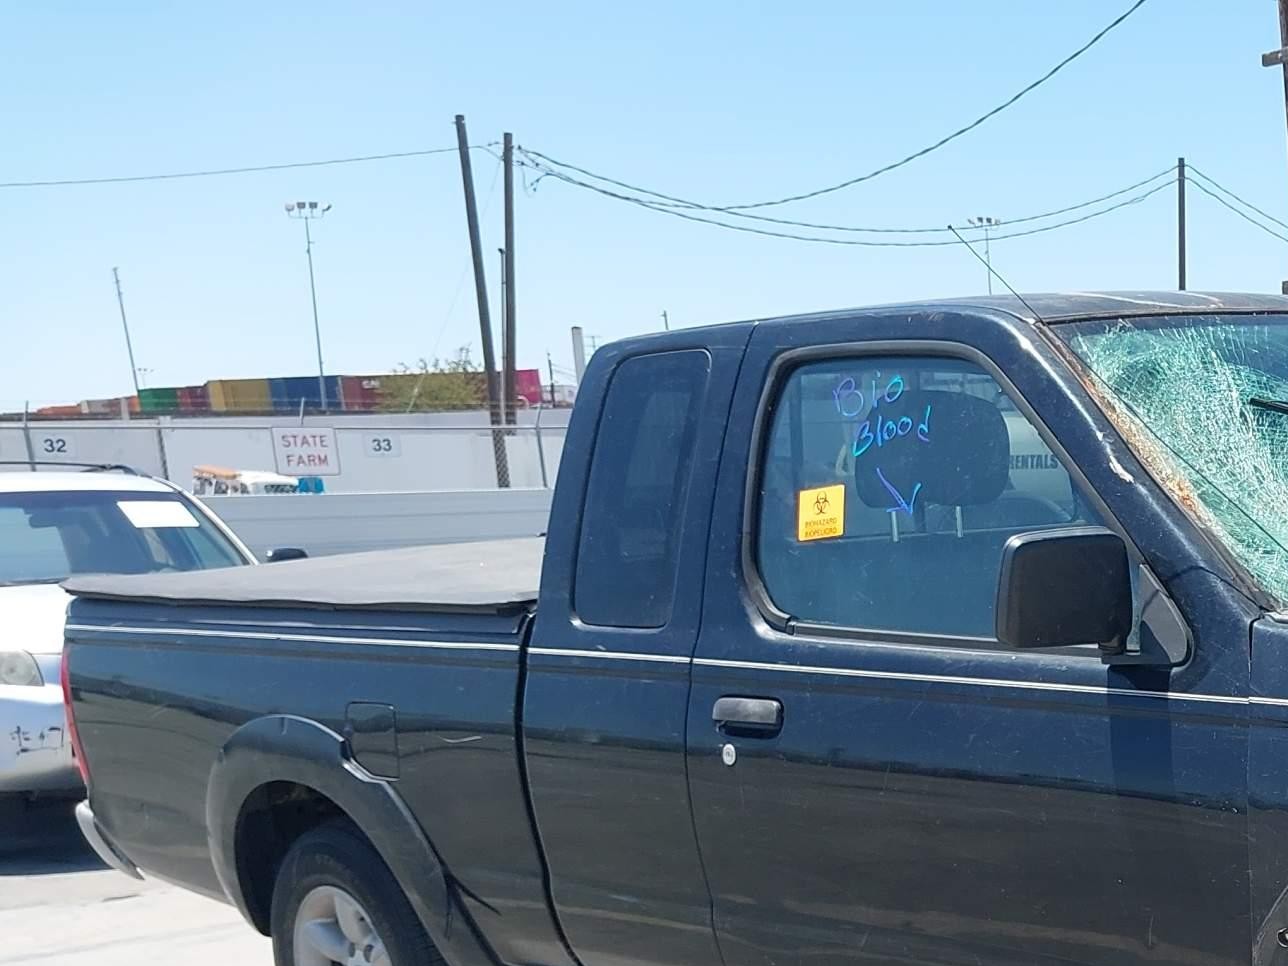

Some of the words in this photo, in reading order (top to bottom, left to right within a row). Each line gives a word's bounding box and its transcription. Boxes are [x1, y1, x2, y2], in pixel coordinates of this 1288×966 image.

[832, 371, 904, 417] Bio
[852, 404, 932, 457] Blood
[43, 438, 67, 453] 32
[281, 435, 329, 449] STATE
[371, 438, 393, 452] 33
[286, 454, 330, 468] FARM
